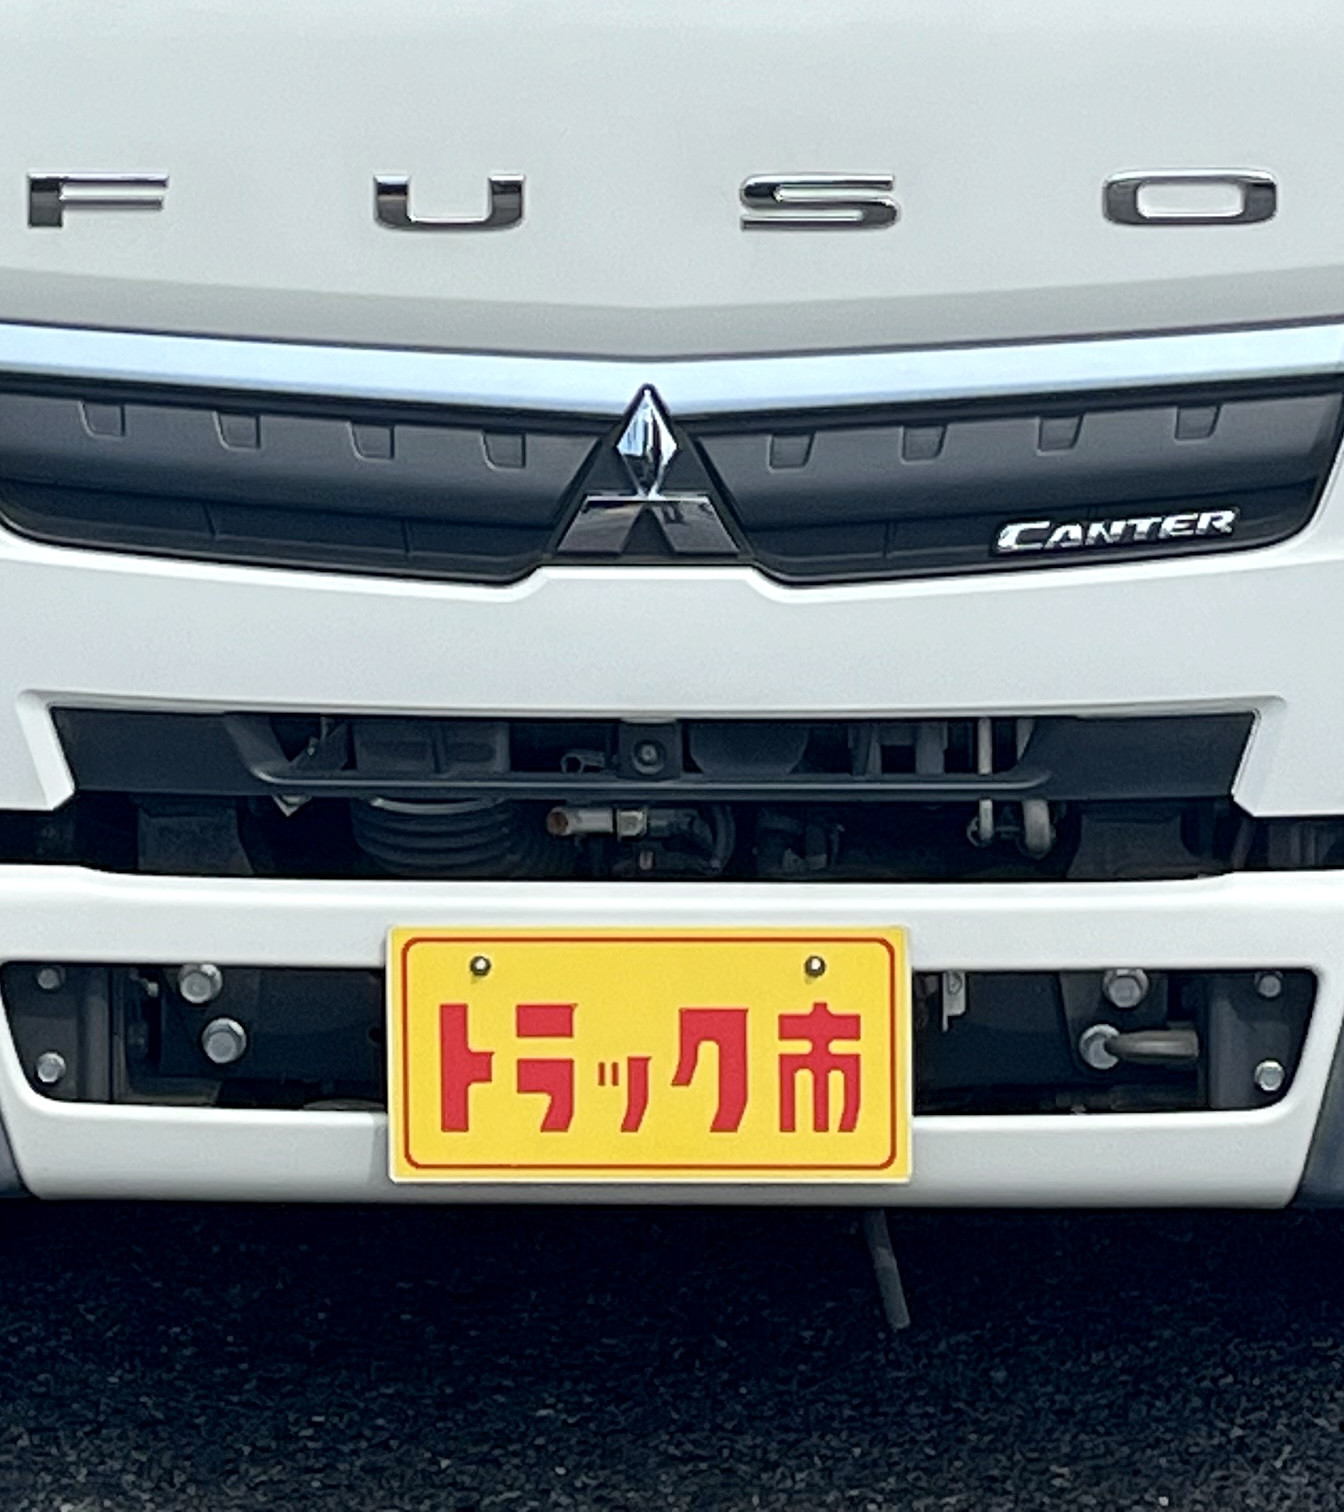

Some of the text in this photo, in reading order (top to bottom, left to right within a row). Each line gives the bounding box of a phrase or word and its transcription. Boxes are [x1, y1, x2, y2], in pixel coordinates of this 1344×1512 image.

[27, 168, 1278, 233] FUSO
[996, 507, 1239, 553] CANTER
[438, 1001, 862, 1135] トラック市
